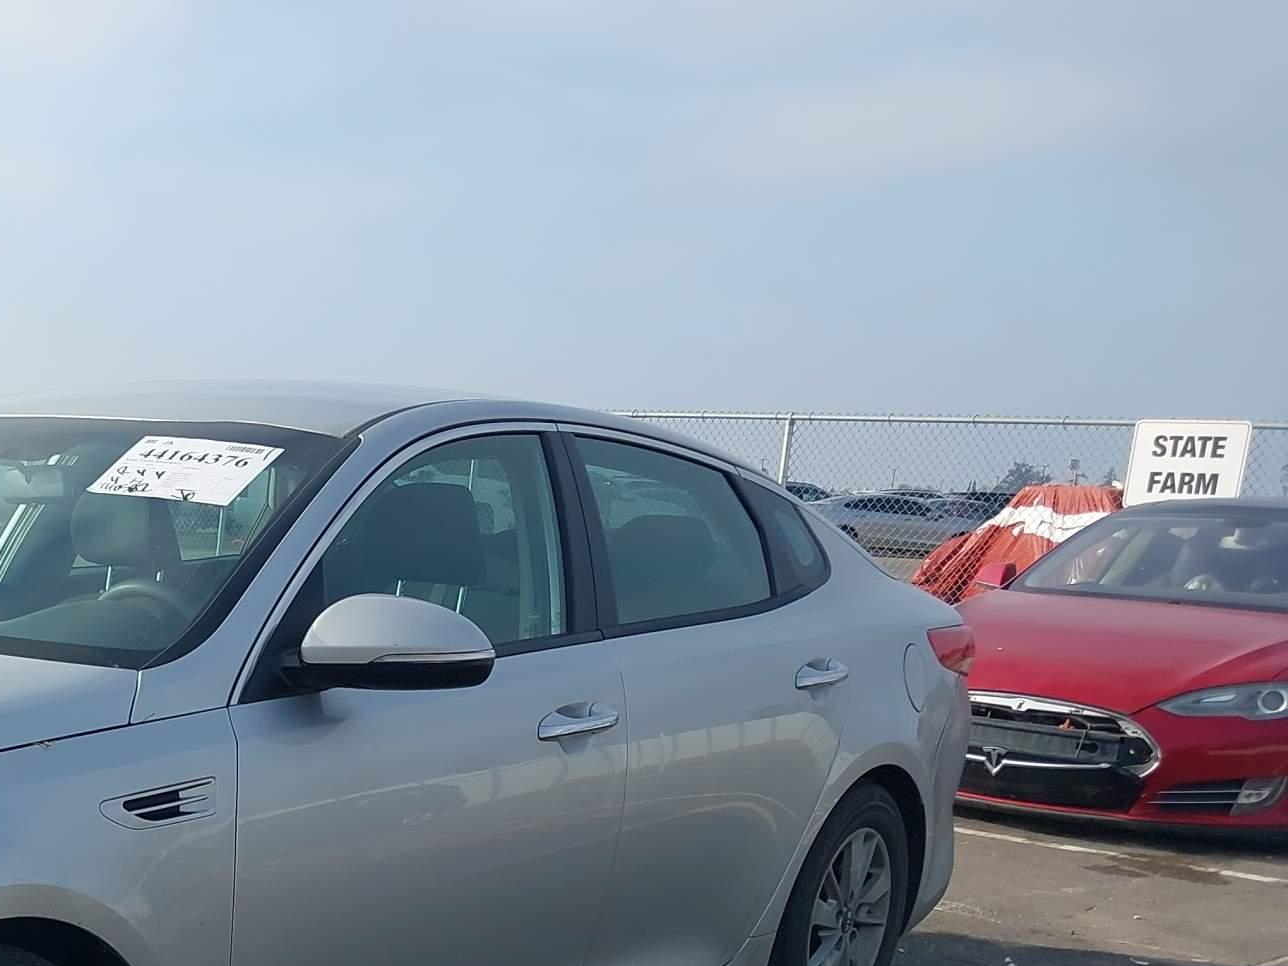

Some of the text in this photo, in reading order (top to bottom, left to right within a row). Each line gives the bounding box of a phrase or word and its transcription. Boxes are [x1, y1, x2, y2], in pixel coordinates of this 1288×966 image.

[139, 448, 252, 468] 44164376
[1151, 435, 1228, 459] STATE
[1146, 471, 1220, 496] FARM
